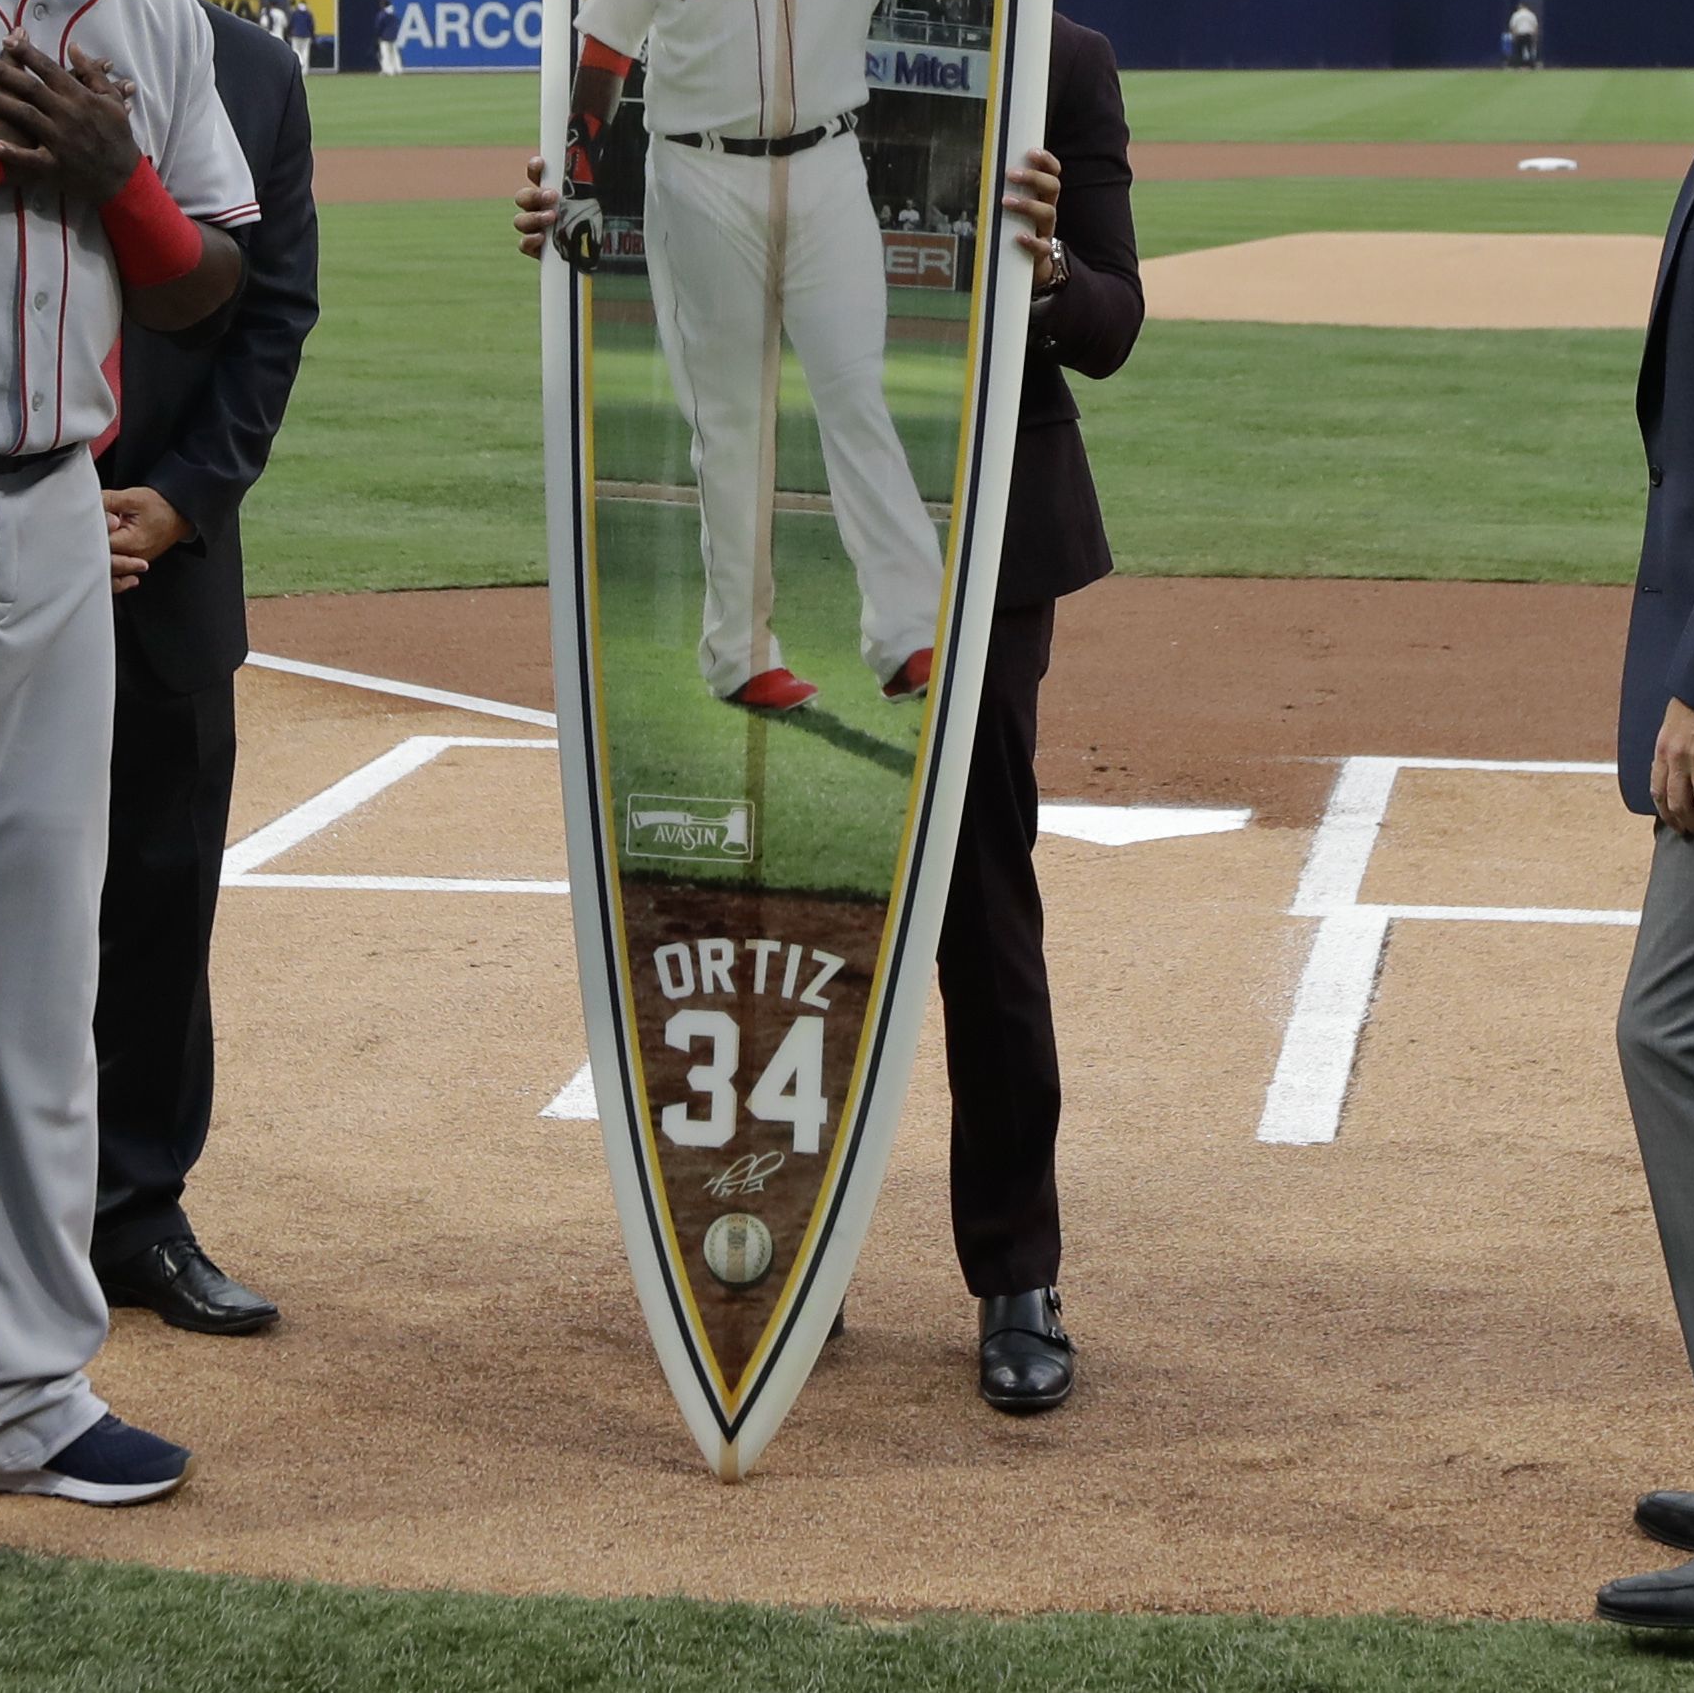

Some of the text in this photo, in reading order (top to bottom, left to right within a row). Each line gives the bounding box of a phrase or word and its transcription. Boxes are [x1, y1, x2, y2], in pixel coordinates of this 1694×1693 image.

[395, 1, 543, 49] ARCO
[894, 51, 971, 91] Mitel
[653, 824, 718, 851] AVASIN
[652, 937, 846, 1010] ORTIZ
[661, 1009, 828, 1154] 34
